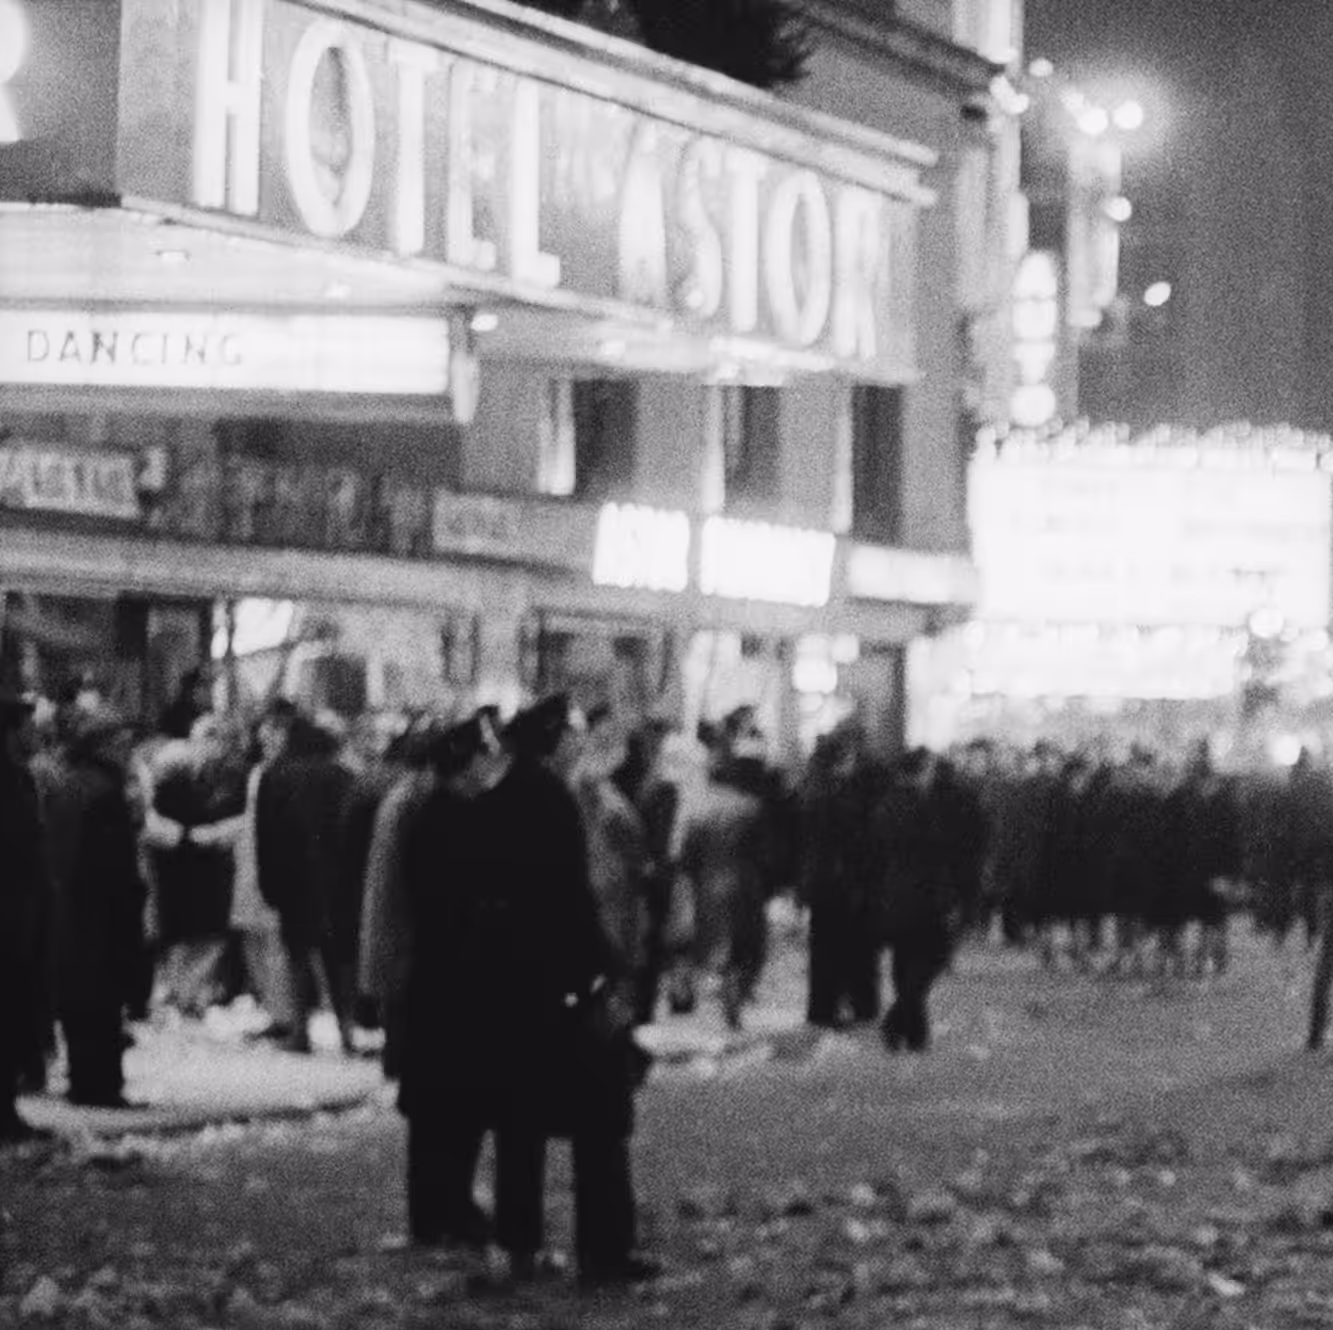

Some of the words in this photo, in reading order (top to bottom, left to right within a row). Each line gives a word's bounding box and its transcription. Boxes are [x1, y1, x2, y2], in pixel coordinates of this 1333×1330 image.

[196, 0, 562, 290] HOTEL
[616, 116, 892, 362] ASTOR
[25, 328, 246, 368] DANCING
